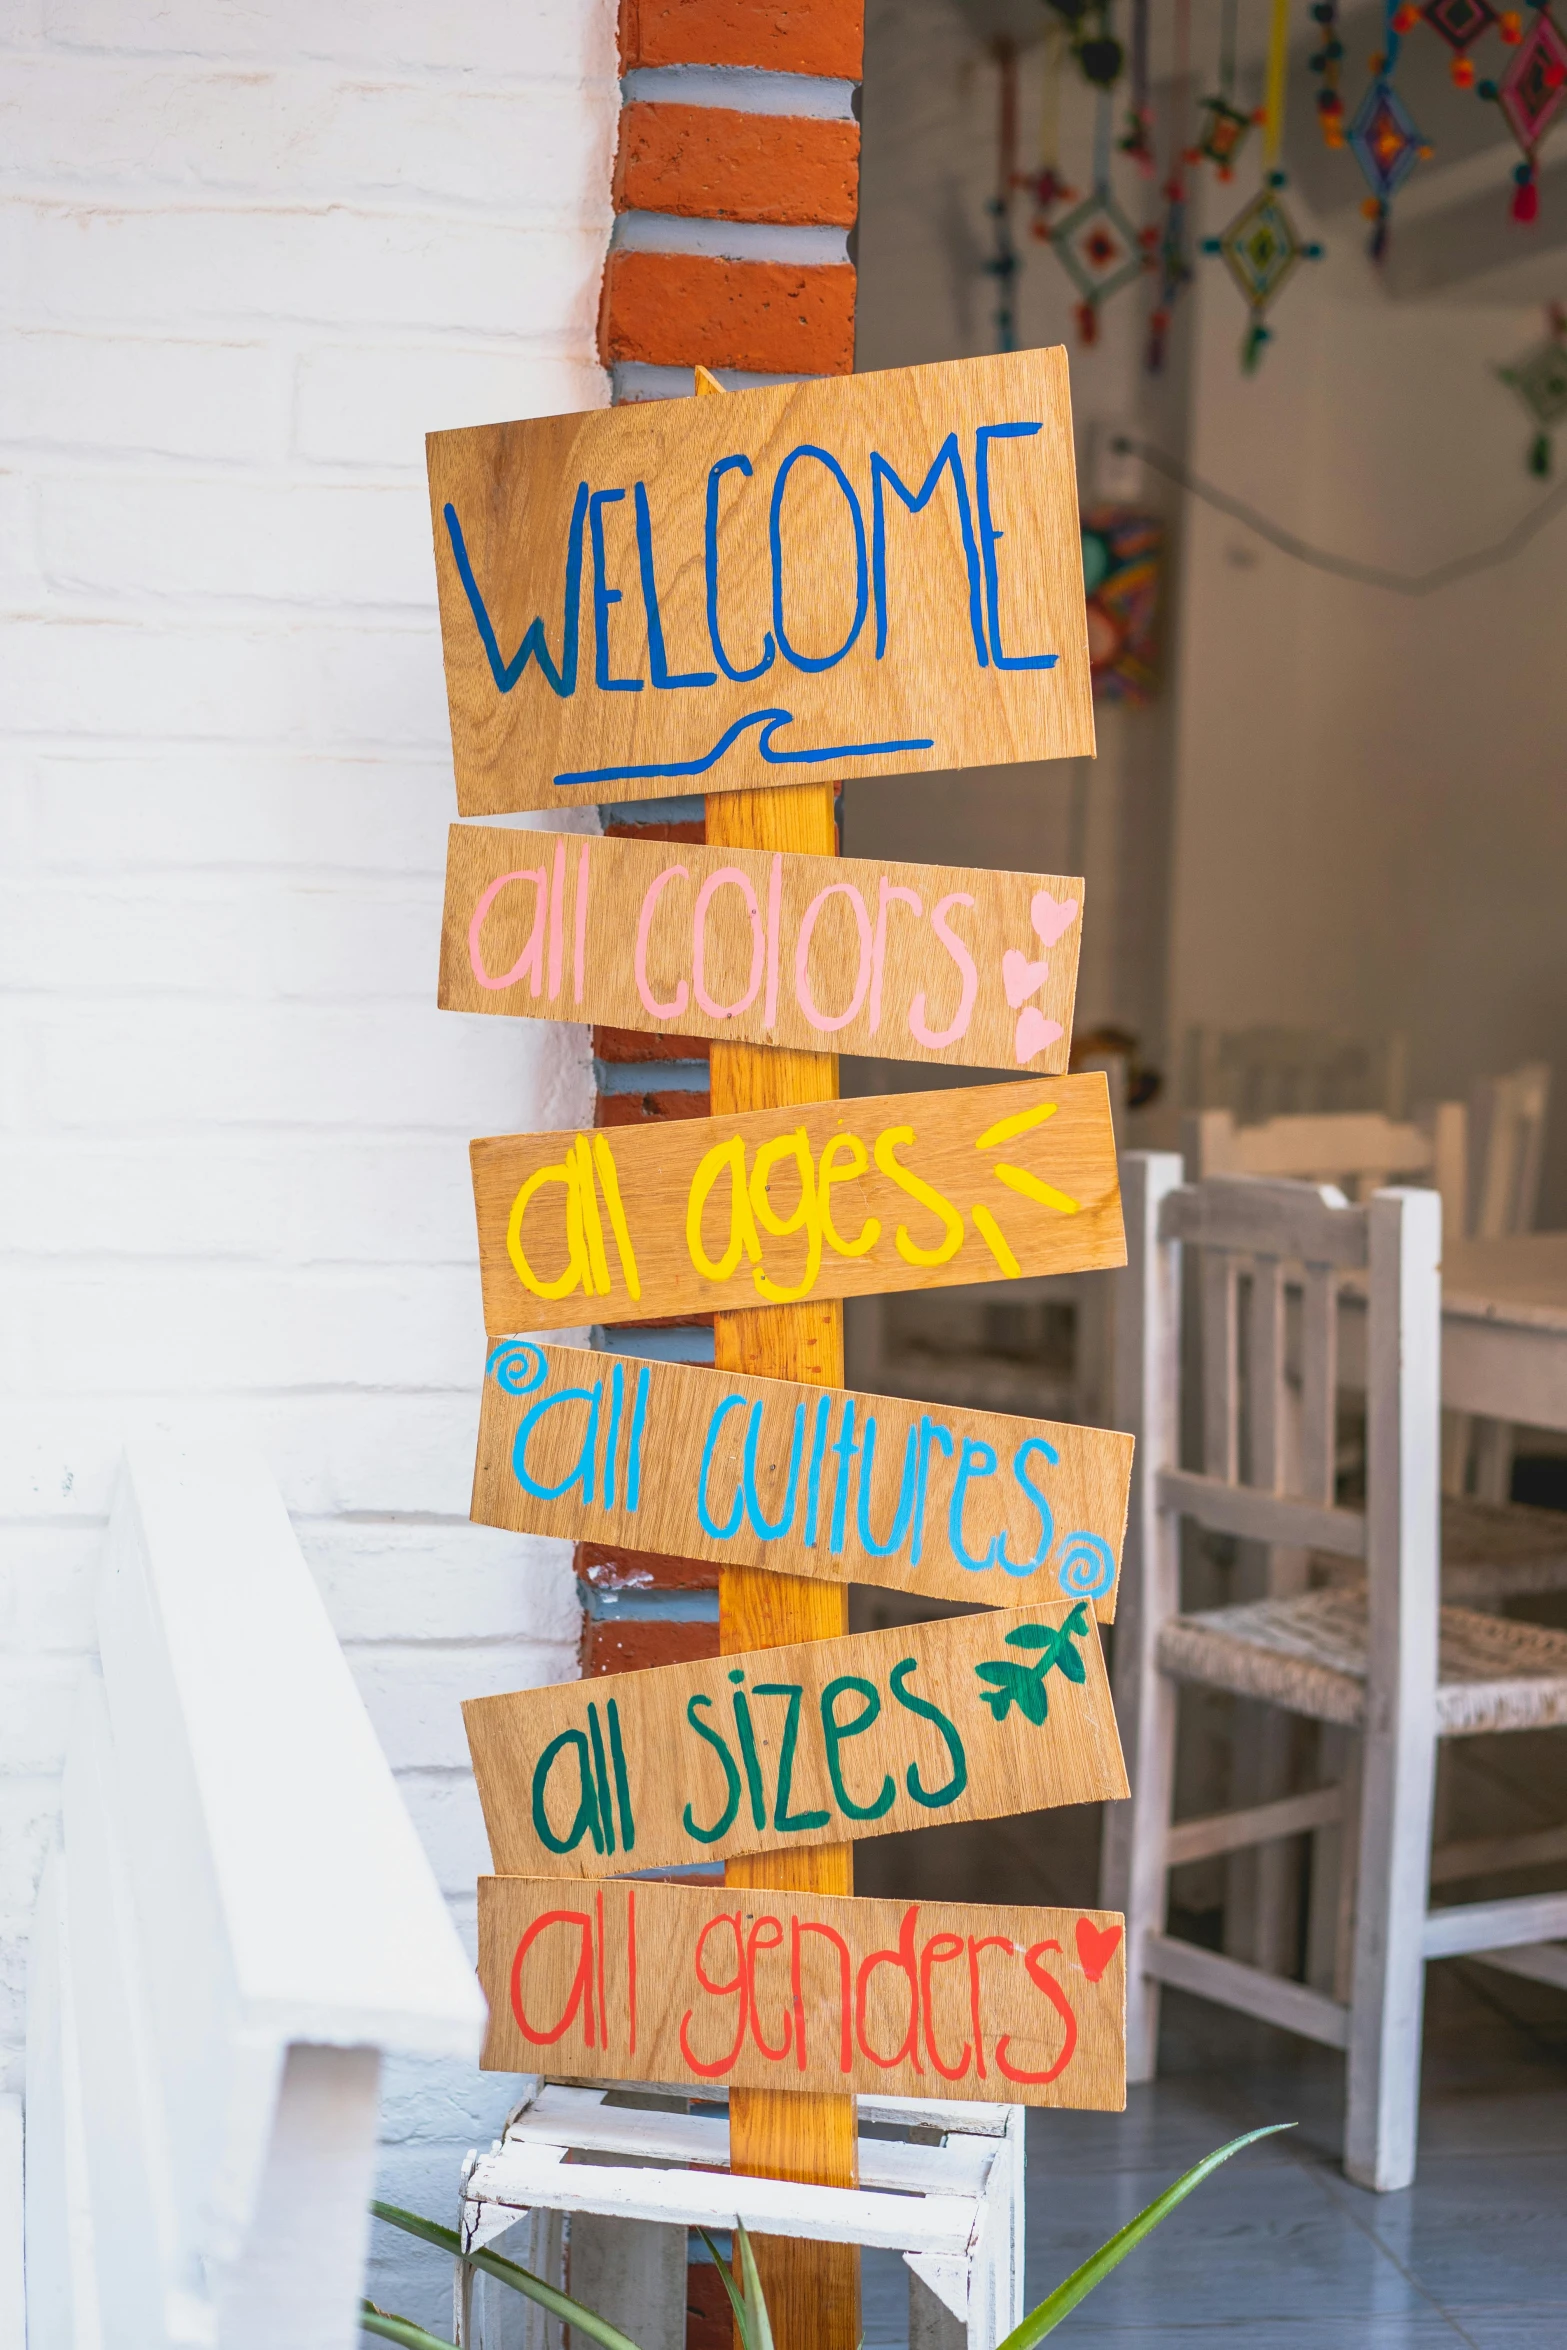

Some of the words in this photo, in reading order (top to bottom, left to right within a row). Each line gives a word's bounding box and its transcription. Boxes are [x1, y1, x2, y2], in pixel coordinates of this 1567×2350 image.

[444, 422, 1060, 698] WELCOME
[468, 838, 590, 1005] all
[635, 853, 978, 1049] colors
[507, 1132, 641, 1302] all
[686, 1125, 965, 1303] ages
[512, 1362, 650, 1513] all
[697, 1394, 1061, 1578] cultures
[532, 1698, 635, 1856] all
[682, 1657, 969, 1844] sizes
[511, 1890, 637, 2056] all
[679, 1905, 1078, 2084] genders
